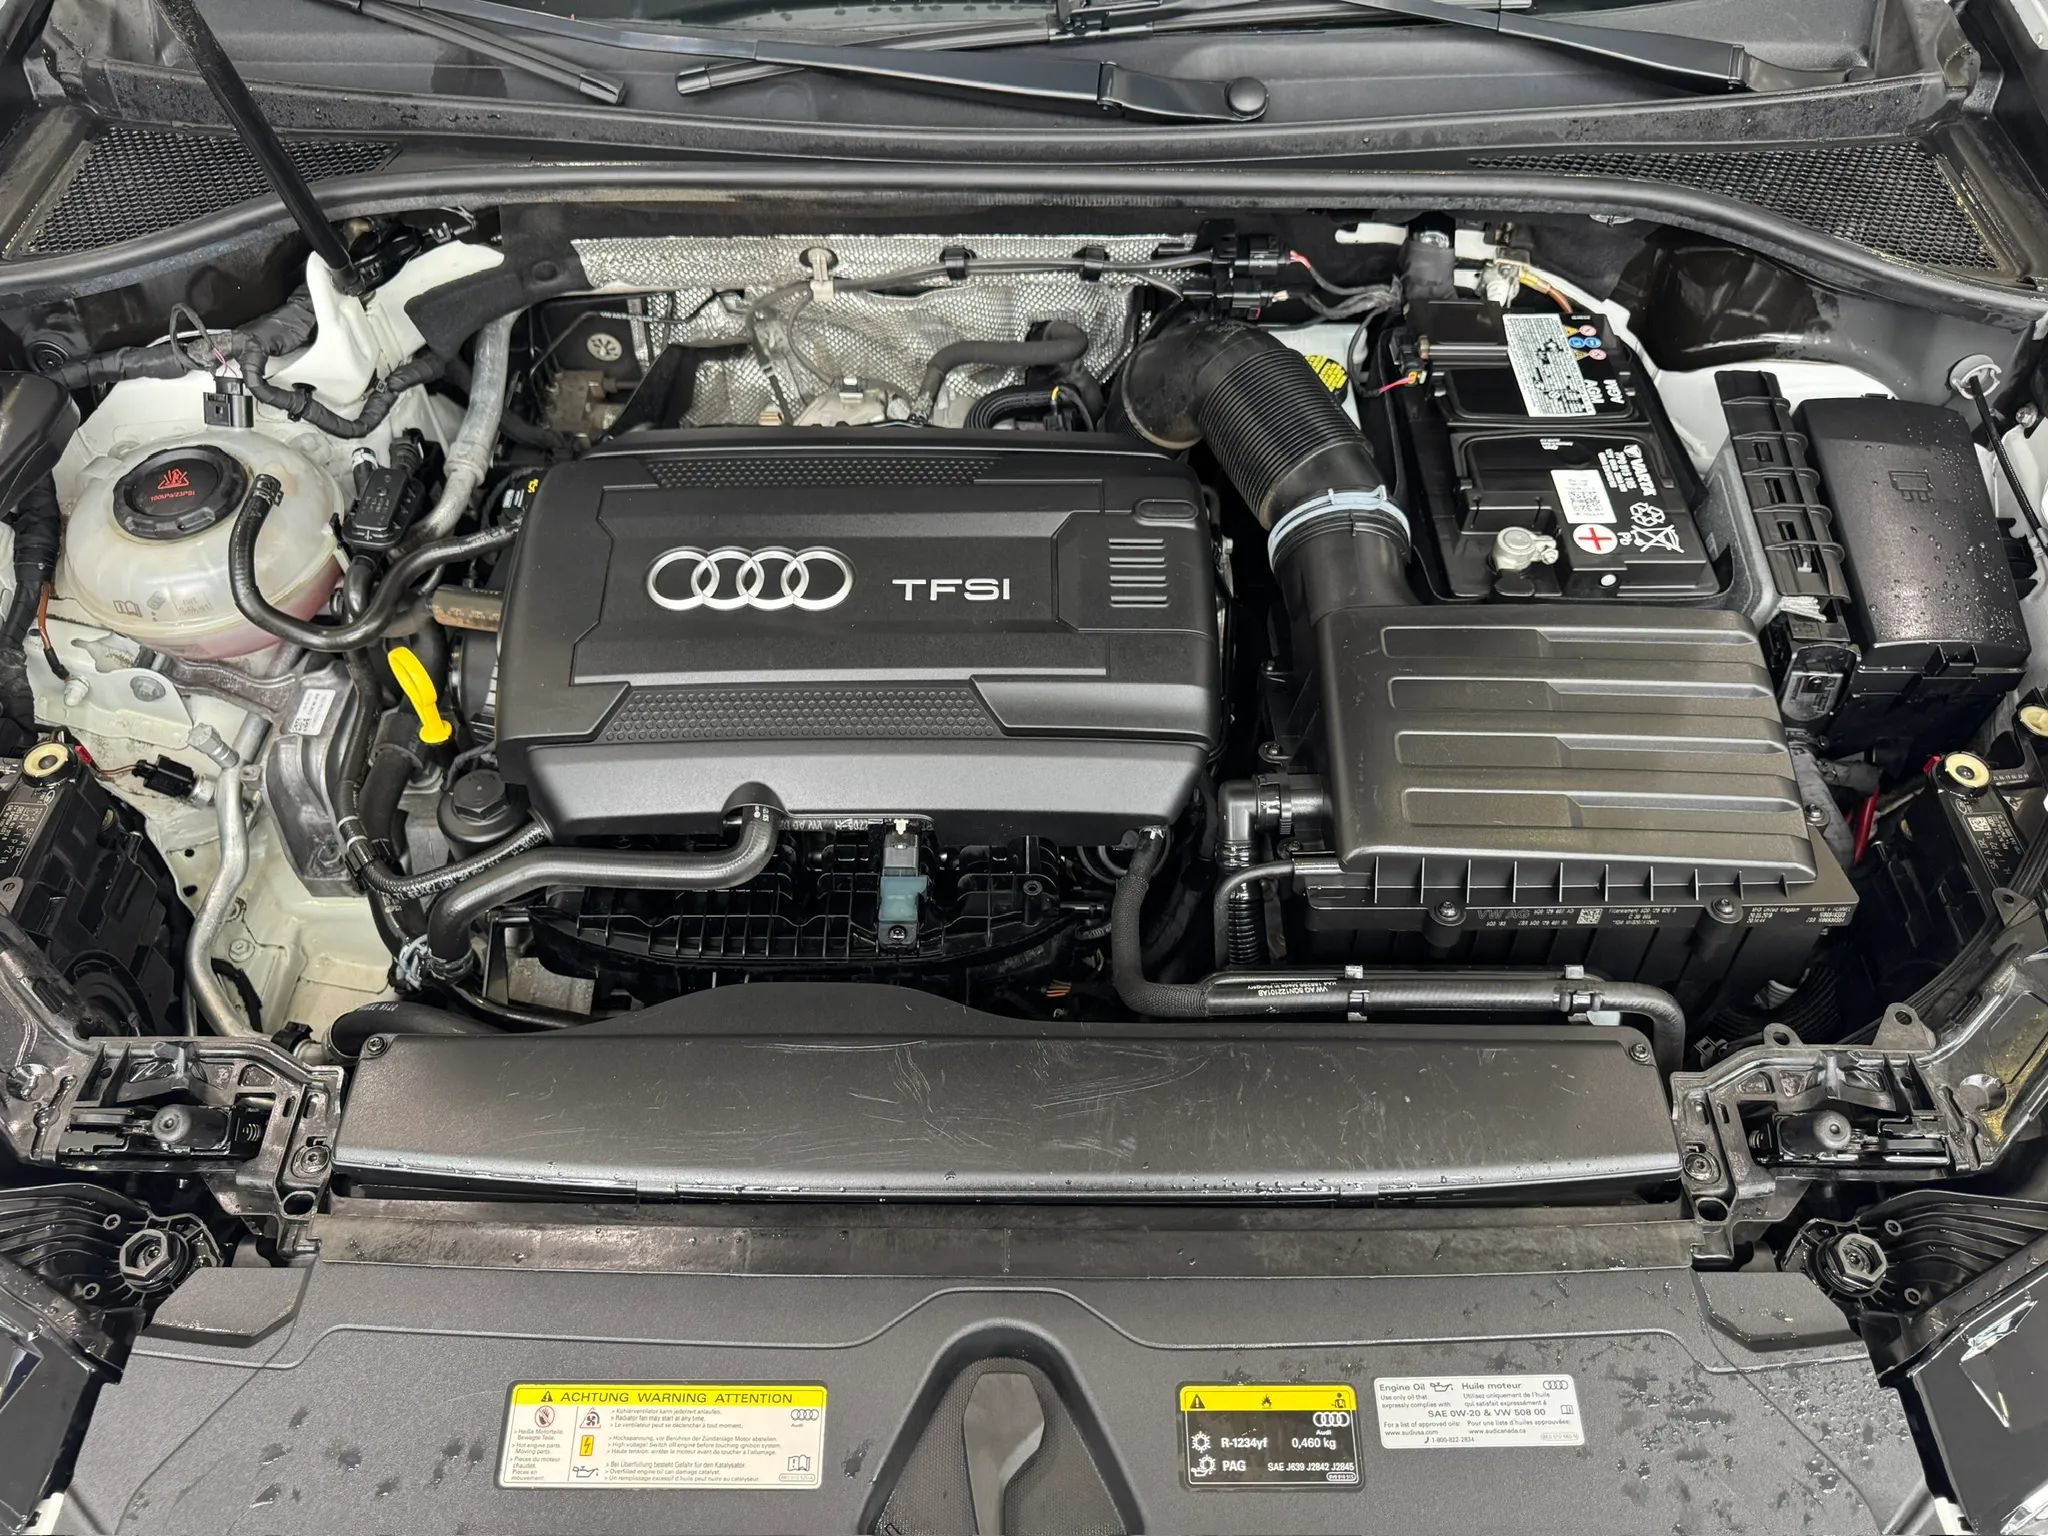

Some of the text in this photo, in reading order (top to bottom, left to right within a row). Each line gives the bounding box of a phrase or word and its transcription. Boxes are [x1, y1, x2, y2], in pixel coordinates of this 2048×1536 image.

[1584, 379, 1605, 403] AGM
[1603, 379, 1625, 404] AGM
[1630, 458, 1657, 496] VARTA
[1617, 532, 1633, 545] Pb
[892, 578, 1010, 600] TFSI
[1477, 910, 1502, 920] VW
[1379, 1383, 1426, 1392] Engine Oil
[560, 1392, 793, 1404] ACHTUNG WARNING ATTENTION
[1221, 1437, 1336, 1450] R-1234yf 0,460 kg
[1222, 1460, 1247, 1471] PAG
[1267, 1461, 1354, 1471] SAE J639 J2842 J2845
